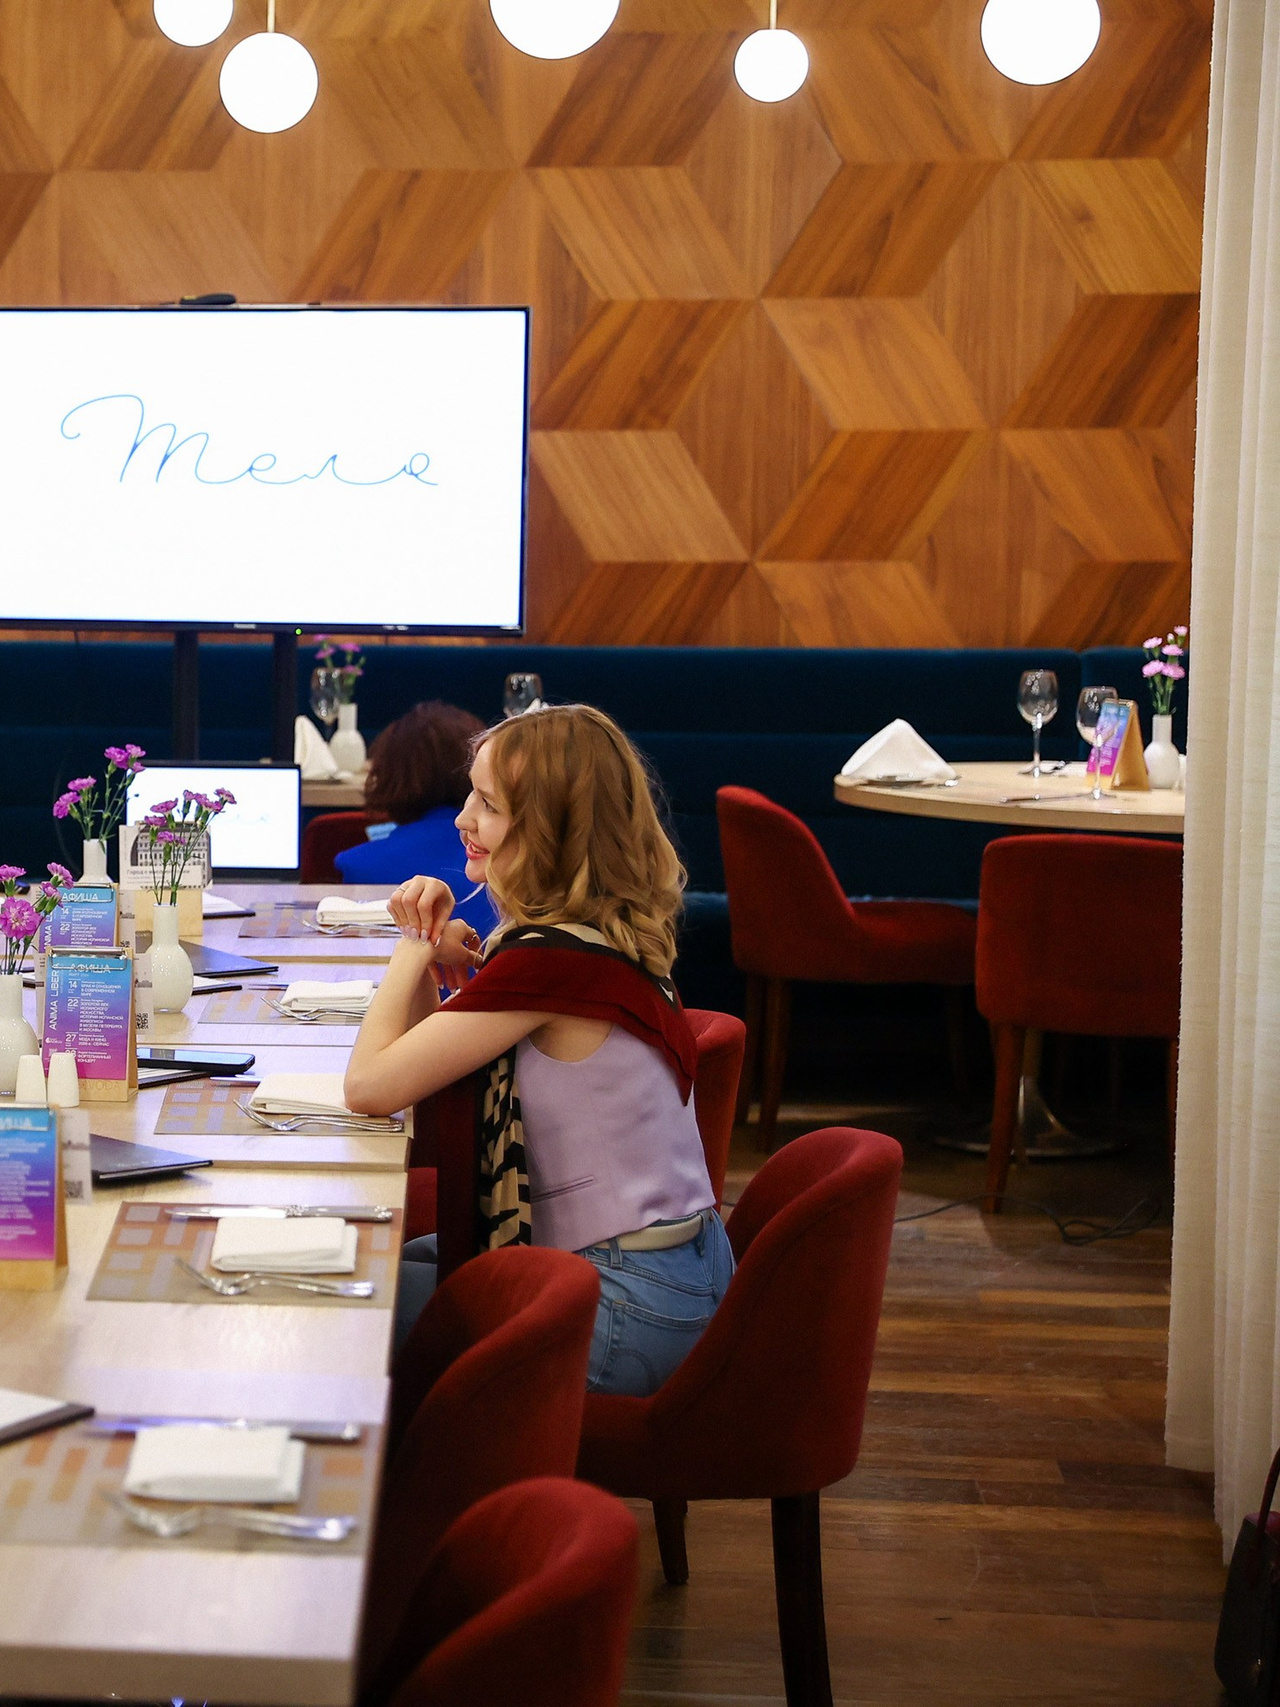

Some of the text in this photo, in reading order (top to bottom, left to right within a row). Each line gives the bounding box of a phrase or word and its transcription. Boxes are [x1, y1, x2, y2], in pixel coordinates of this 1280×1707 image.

[61, 892, 99, 902] АФИША
[44, 925, 52, 950] NIMA
[49, 1000, 58, 1030] ANIMA
